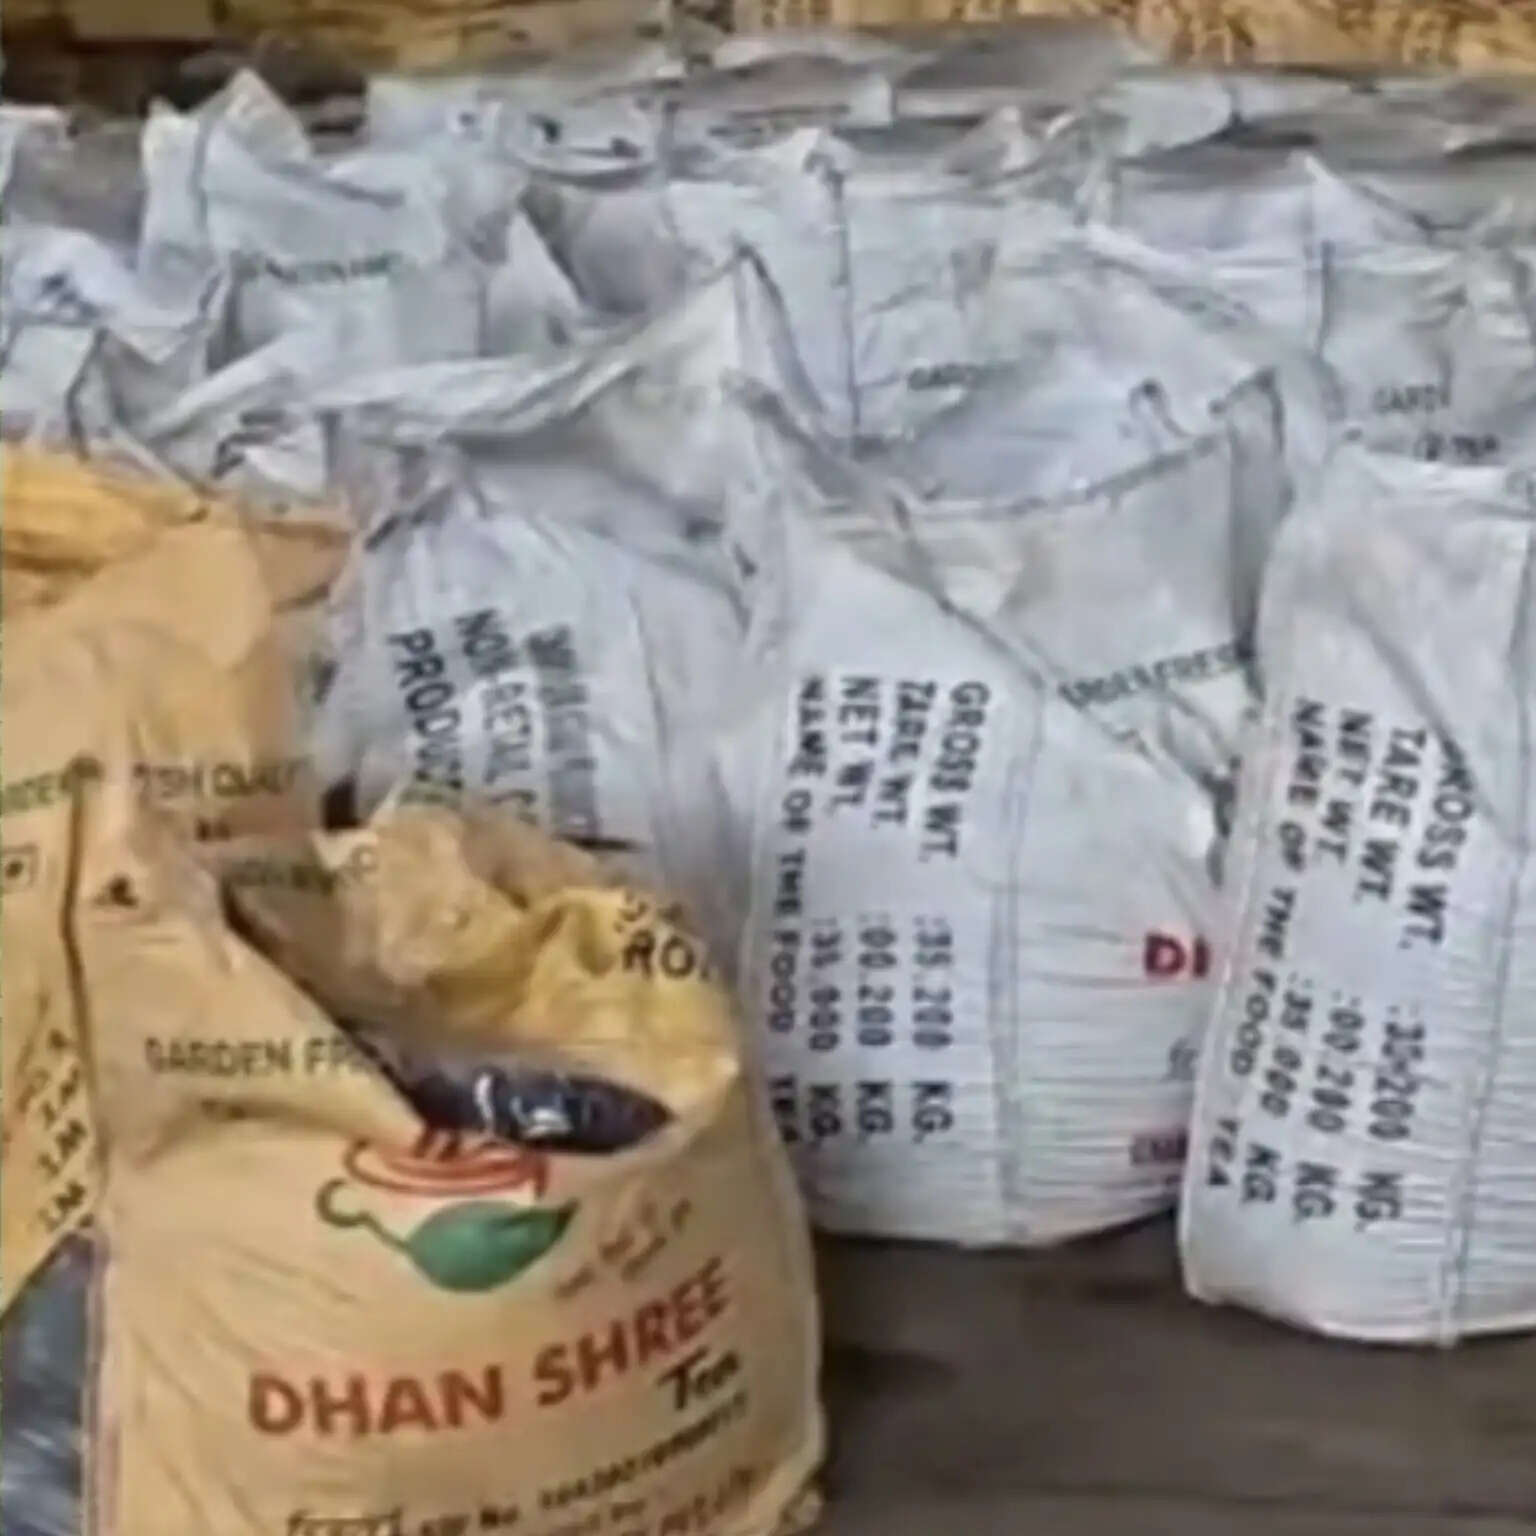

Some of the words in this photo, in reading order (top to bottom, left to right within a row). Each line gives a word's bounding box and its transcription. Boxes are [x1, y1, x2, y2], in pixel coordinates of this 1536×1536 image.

[839, 676, 878, 744] NET
[930, 682, 990, 791] GROSS
[1288, 698, 1325, 807] NAME
[1334, 709, 1373, 787] NET
[1371, 726, 1426, 829] TARE
[1279, 823, 1306, 872] OF
[1256, 887, 1296, 961] THE
[1231, 970, 1274, 1074] FOOD
[1207, 1117, 1241, 1186] TEA
[248, 1363, 504, 1436] DHAN
[535, 1256, 736, 1408] SHREE
